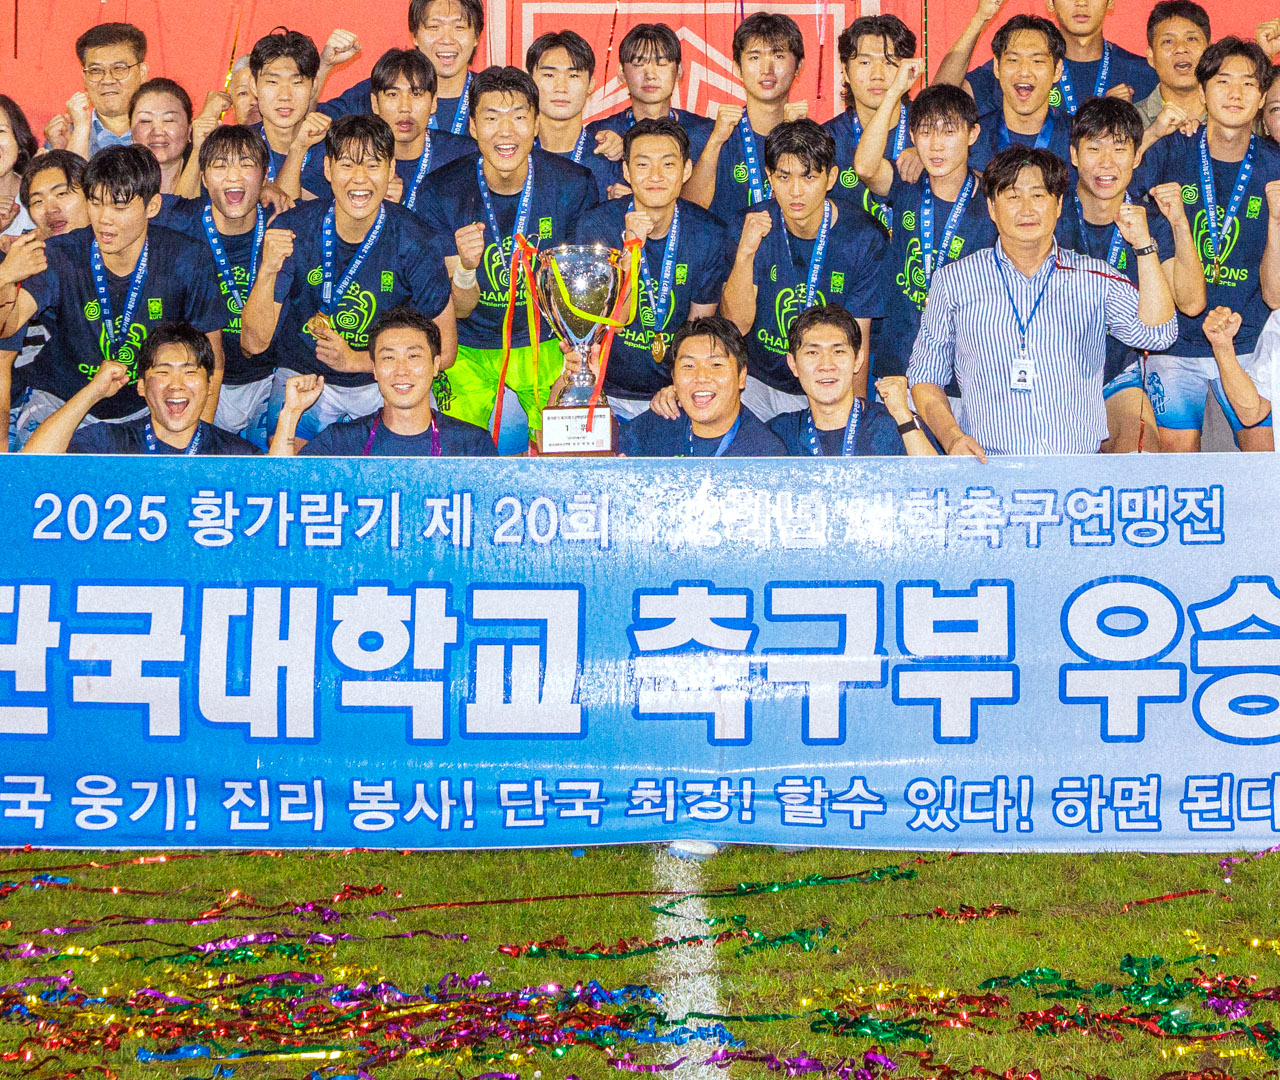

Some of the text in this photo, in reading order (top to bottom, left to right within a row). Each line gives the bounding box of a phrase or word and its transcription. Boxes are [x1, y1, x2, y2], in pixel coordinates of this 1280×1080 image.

[33, 492, 168, 542] 2025
[188, 490, 401, 548] 황가람기
[423, 492, 473, 549] 제
[492, 492, 611, 550] 20회
[631, 582, 1019, 745] 축구부
[71, 775, 196, 832] 웅기!
[223, 778, 323, 832] 진리
[349, 779, 474, 832] 봉사!
[499, 780, 606, 828] 단국
[627, 778, 751, 824] 최강!
[781, 777, 886, 827] 할수
[907, 778, 1031, 832] 있다!
[1053, 775, 1161, 832] 하면
